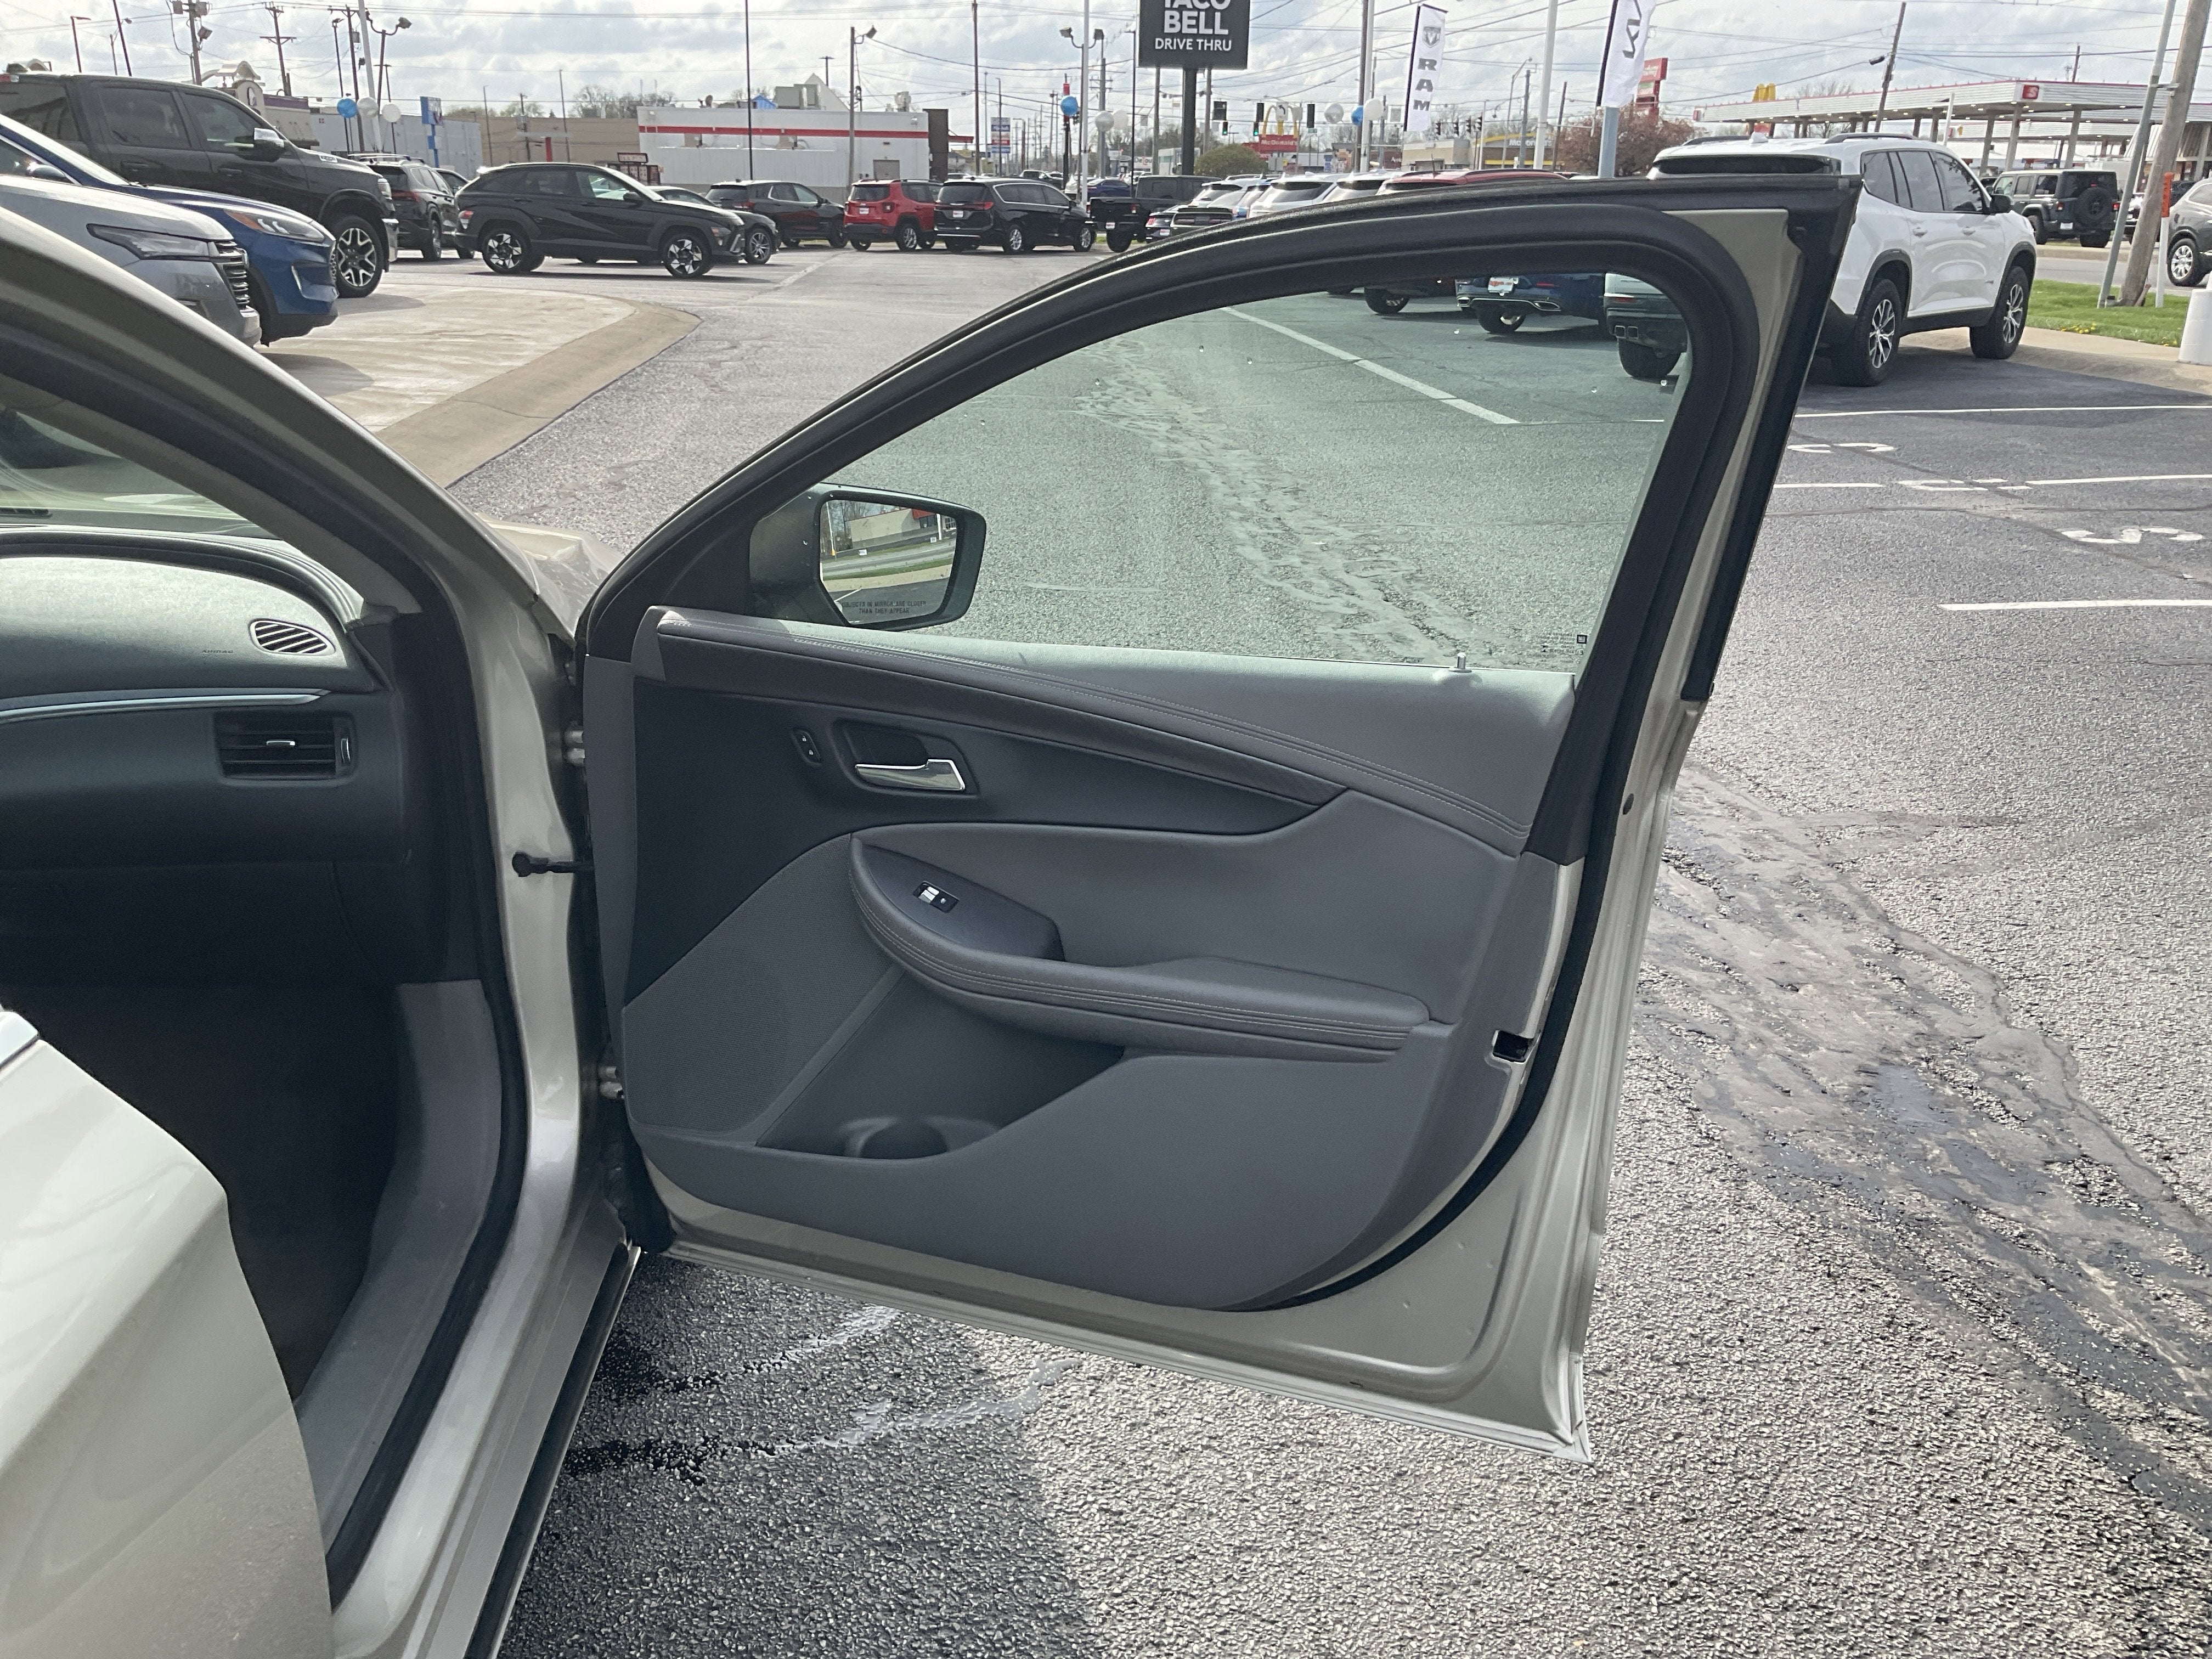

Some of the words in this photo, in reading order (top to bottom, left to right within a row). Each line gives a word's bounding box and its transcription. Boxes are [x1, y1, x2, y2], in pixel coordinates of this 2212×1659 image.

[1164, 10, 1229, 35] BELL
[1155, 38, 1193, 50] DRIVE
[1196, 38, 1232, 51] THRU
[1413, 58, 1437, 111] RAM
